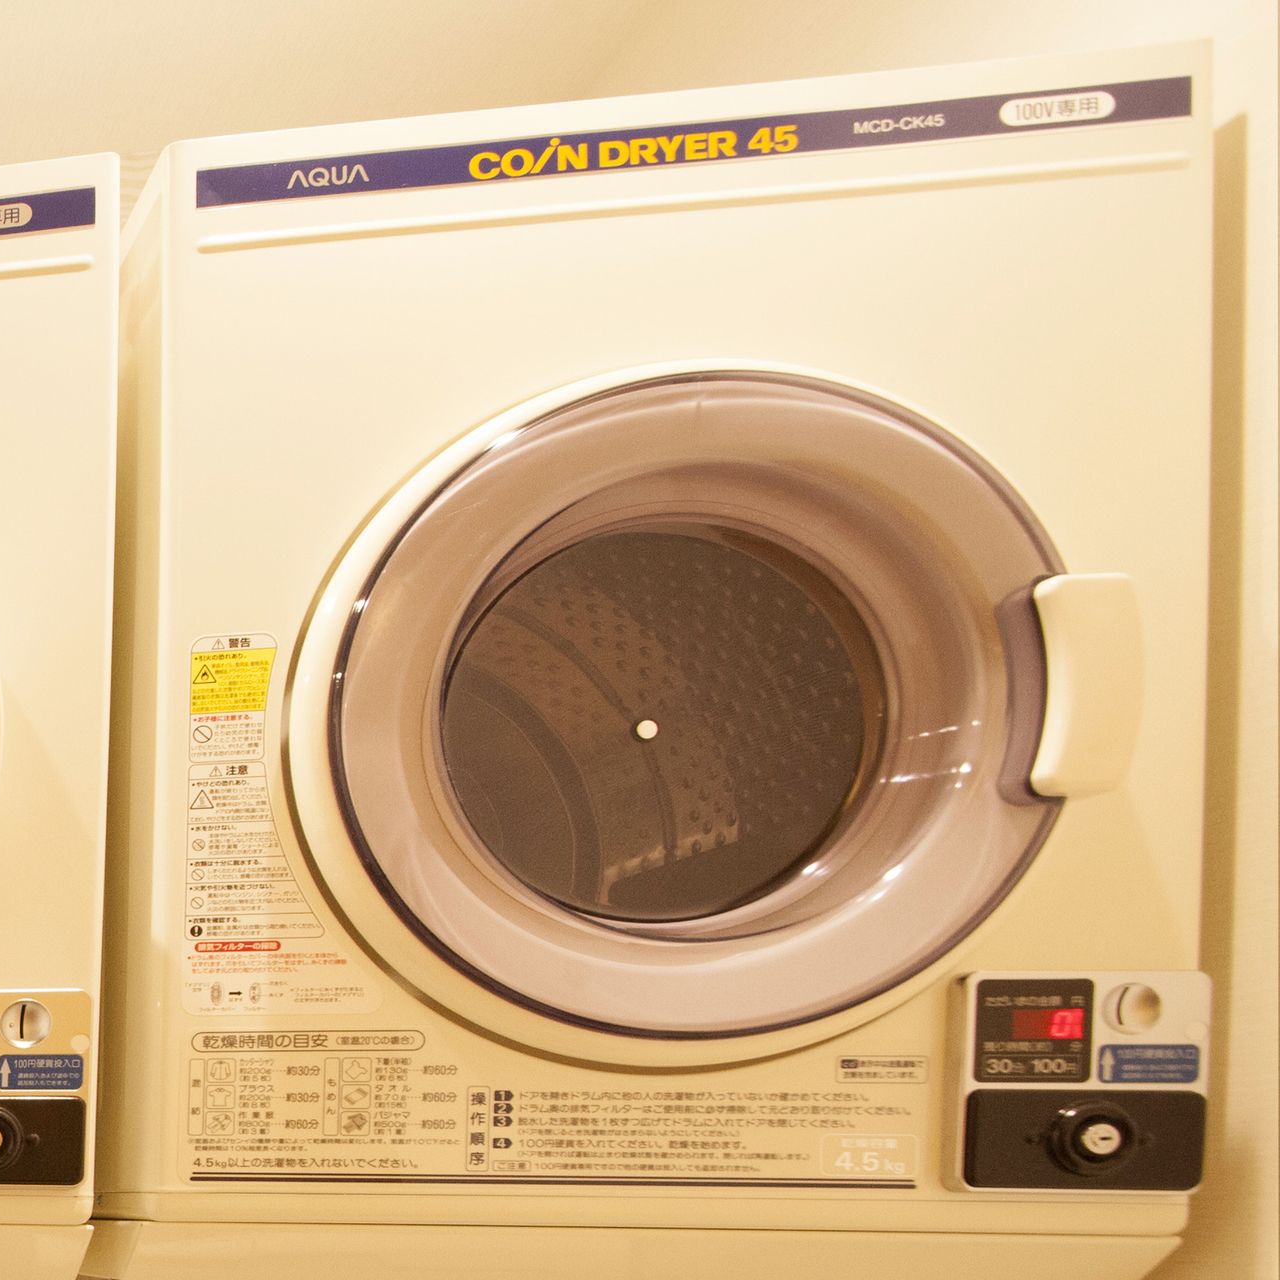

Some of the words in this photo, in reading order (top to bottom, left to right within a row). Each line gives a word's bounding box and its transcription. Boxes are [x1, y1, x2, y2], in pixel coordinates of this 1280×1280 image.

[1013, 95, 1100, 122] 100V専用
[853, 113, 945, 136] MCD-CK45
[598, 128, 738, 169] DRYER
[748, 124, 799, 156] 45
[287, 164, 370, 190] AQUA
[228, 637, 251, 649] 警告
[225, 764, 249, 776] 注意
[202, 1034, 329, 1050] 乾燥時間の目安
